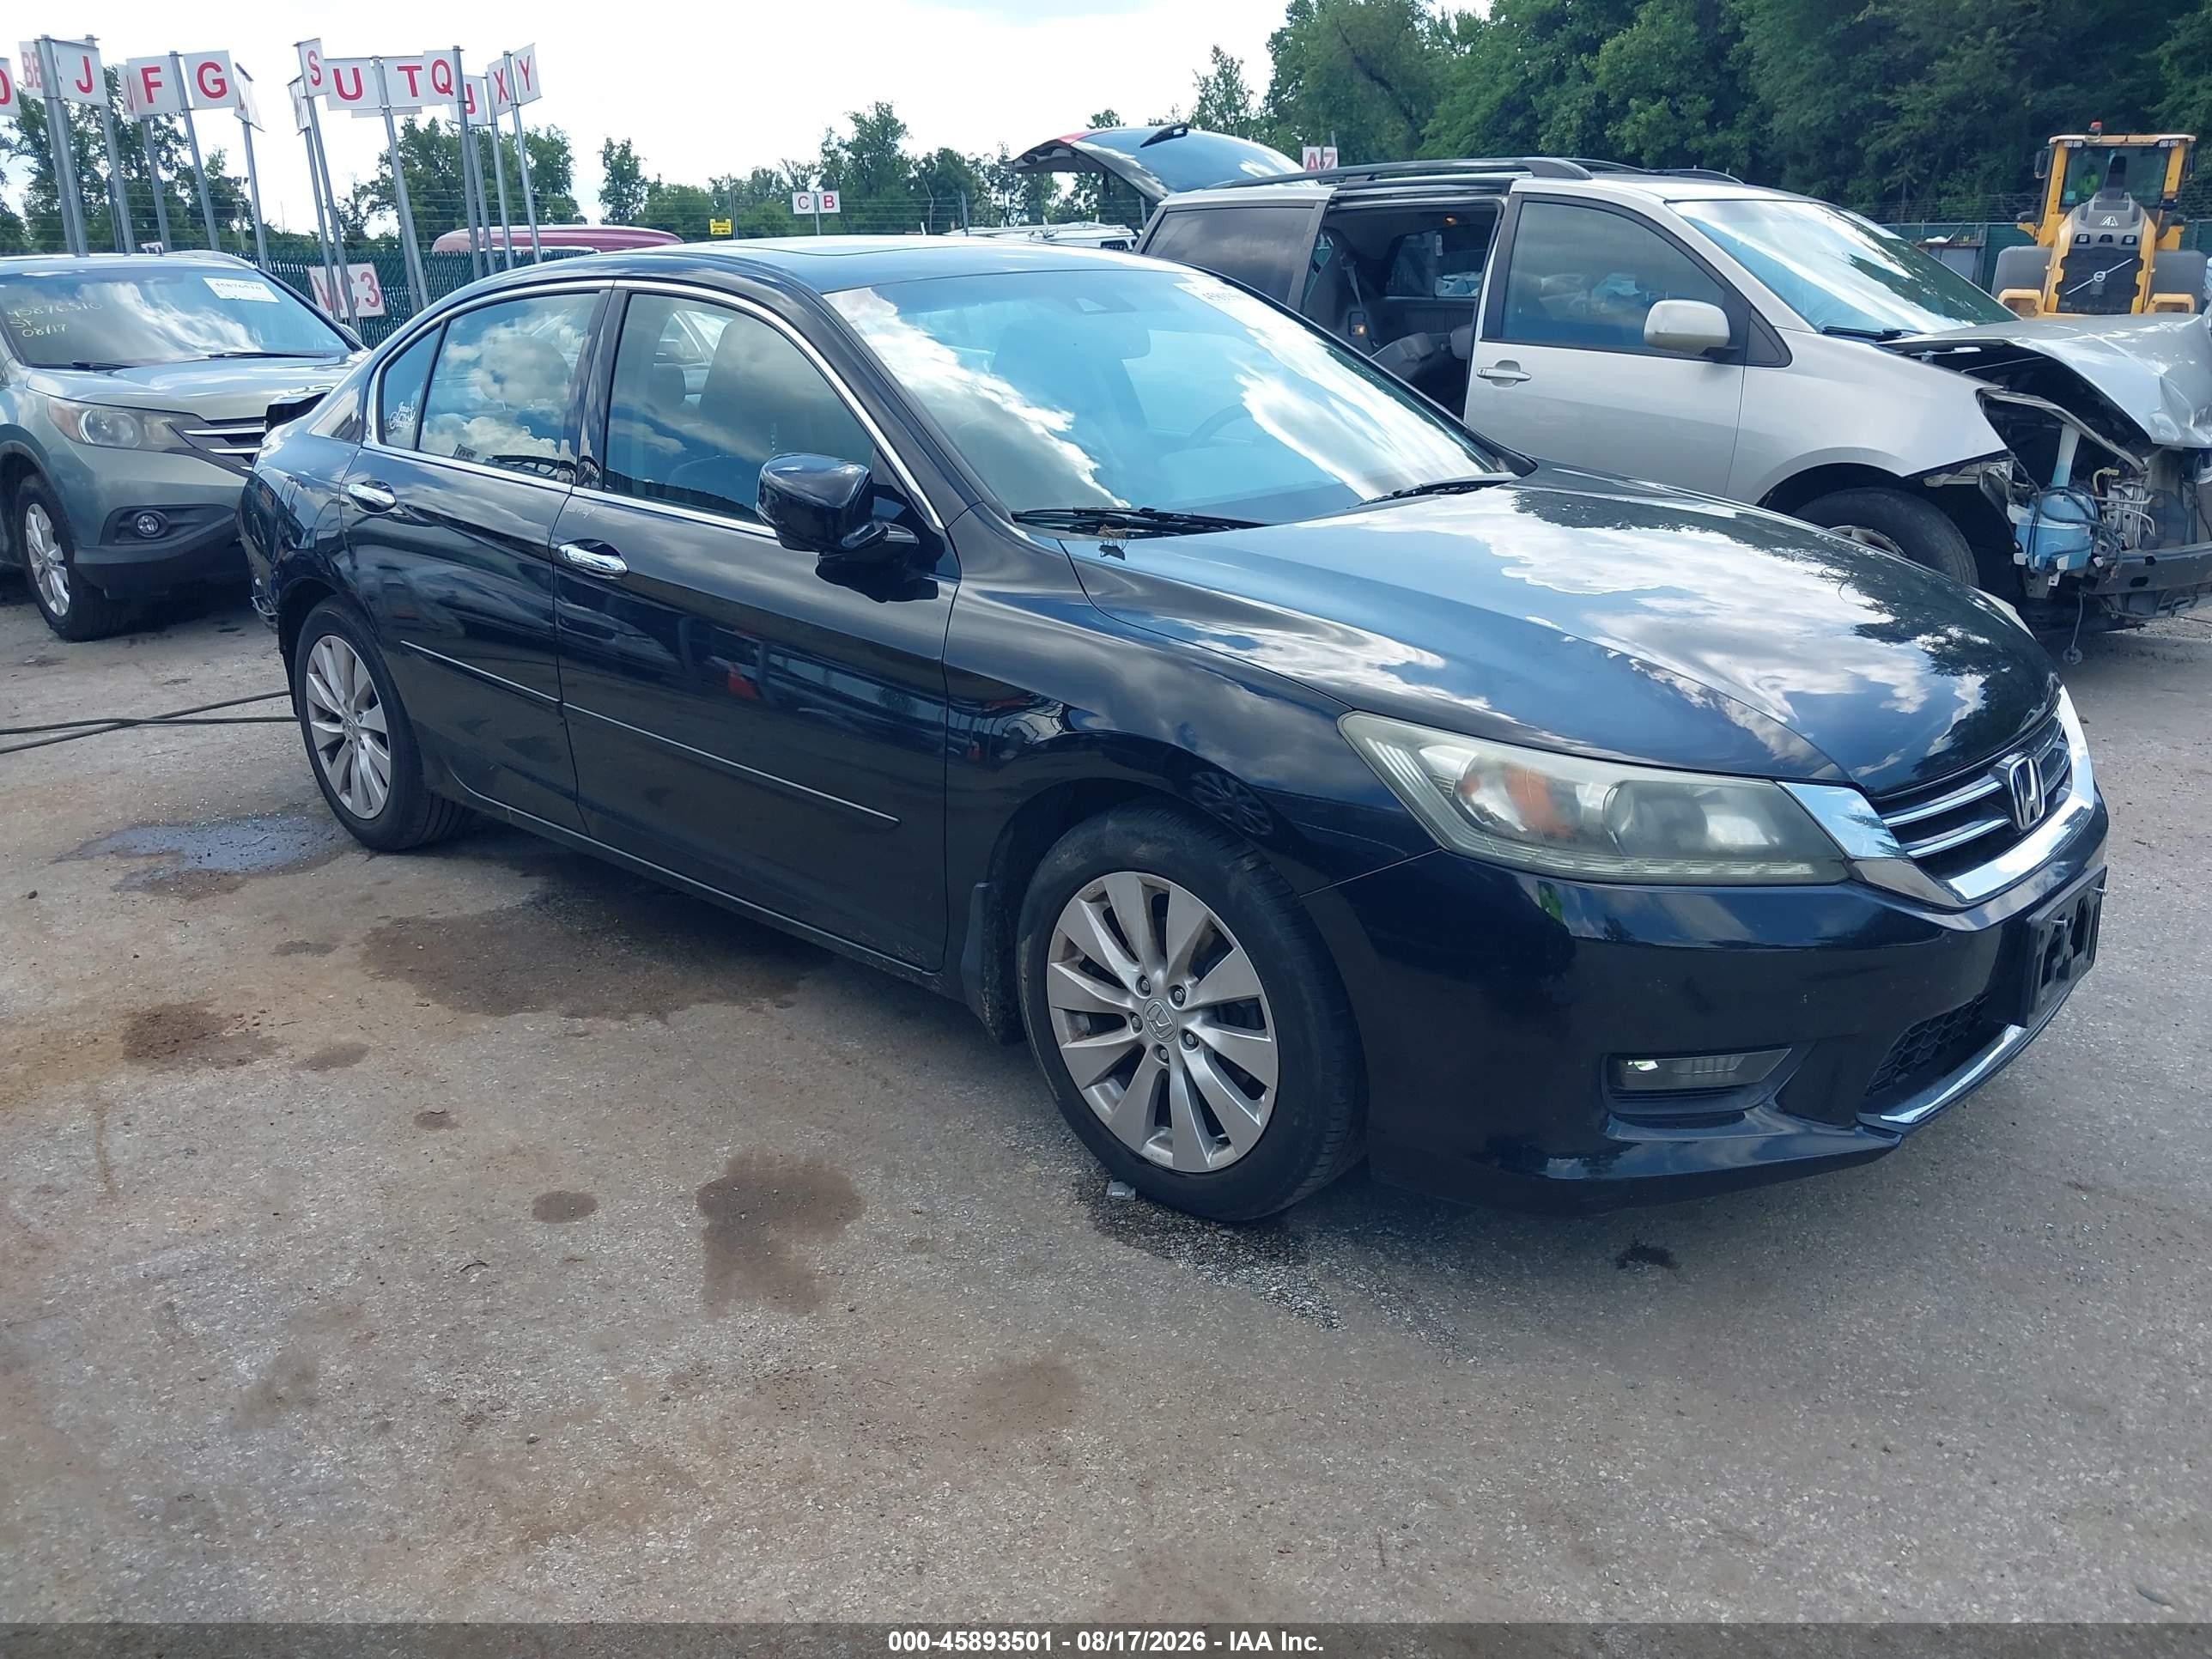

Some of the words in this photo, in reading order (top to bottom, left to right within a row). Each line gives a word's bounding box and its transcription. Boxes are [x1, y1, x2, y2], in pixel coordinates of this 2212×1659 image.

[76, 56, 94, 94] J
[141, 66, 162, 104] F
[197, 62, 228, 99] G
[307, 51, 321, 86] S
[333, 67, 363, 100] U
[397, 65, 422, 97] T
[431, 59, 453, 96] Q
[494, 68, 509, 105] X
[519, 55, 531, 91] Y
[798, 196, 809, 210] C
[823, 195, 835, 209] B
